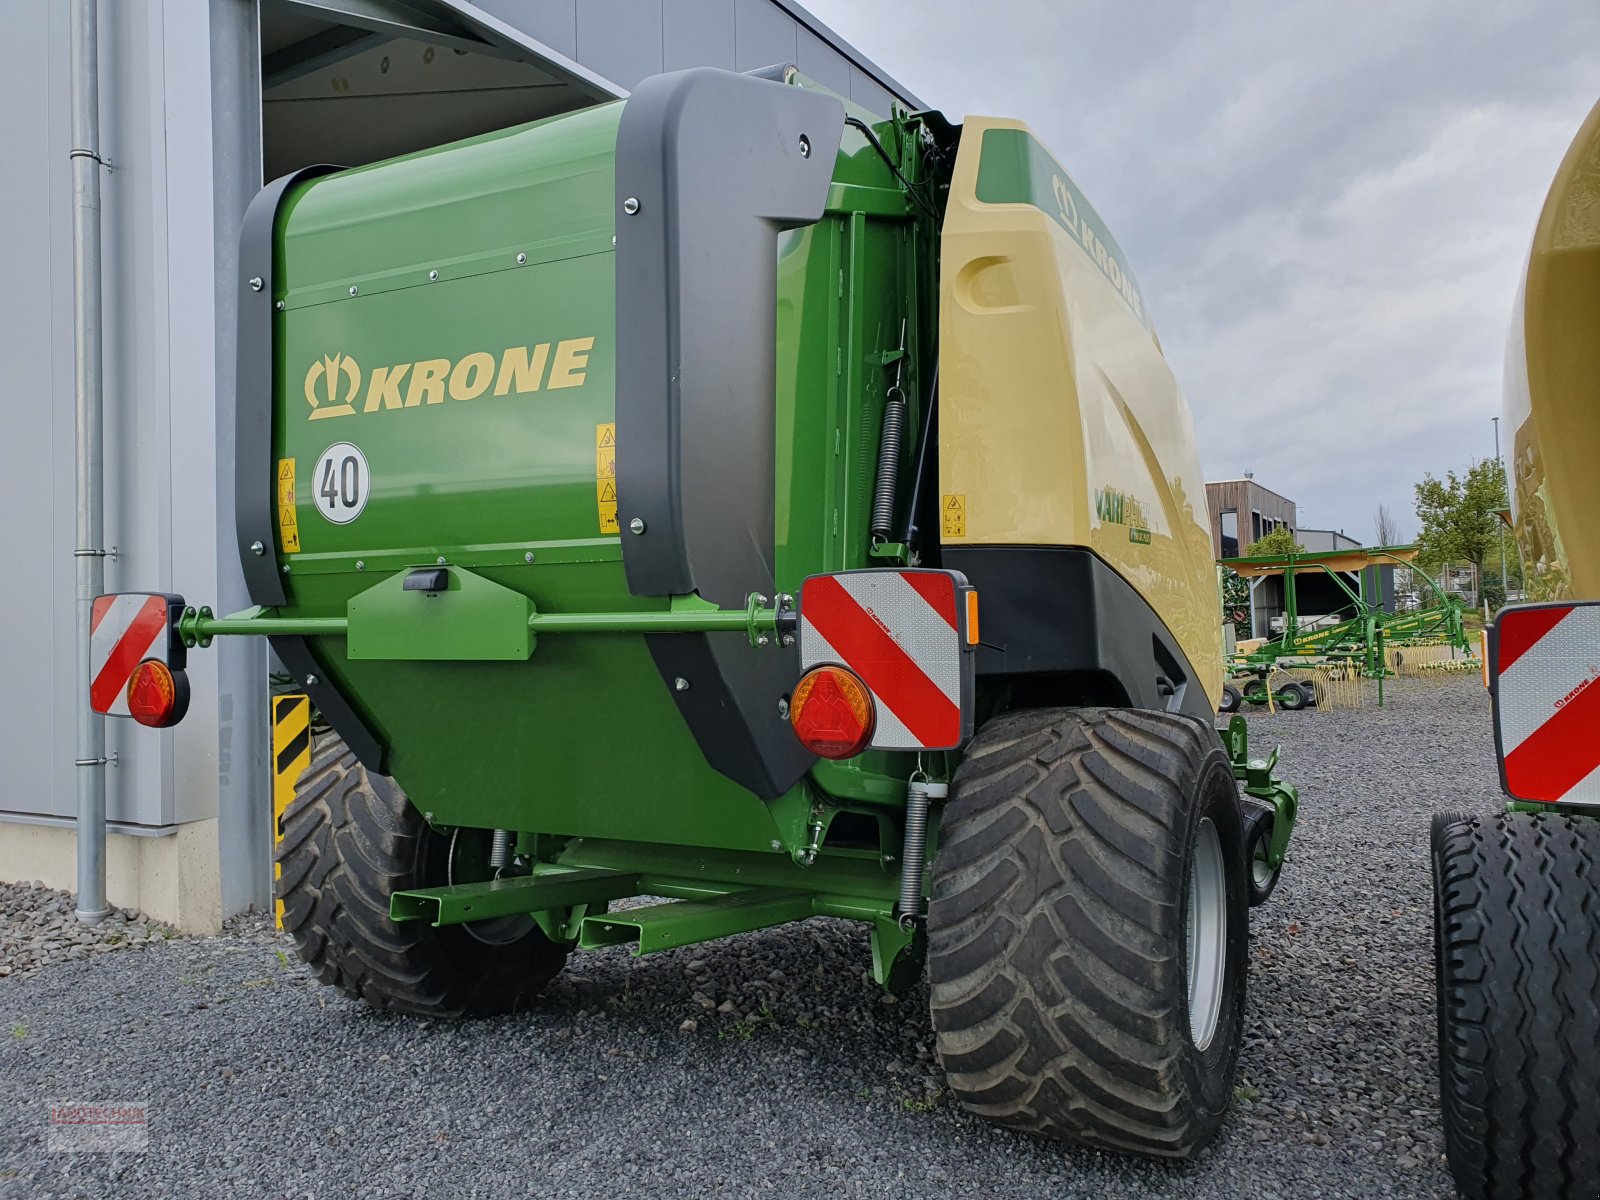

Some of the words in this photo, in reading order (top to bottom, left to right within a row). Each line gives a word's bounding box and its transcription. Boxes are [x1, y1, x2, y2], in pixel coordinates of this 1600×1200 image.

[1081, 219, 1143, 319] KRONE
[363, 336, 595, 413] KRONE
[320, 456, 359, 508] 40
[1303, 630, 1329, 643] KRONE
[1563, 678, 1589, 702] KRONE
